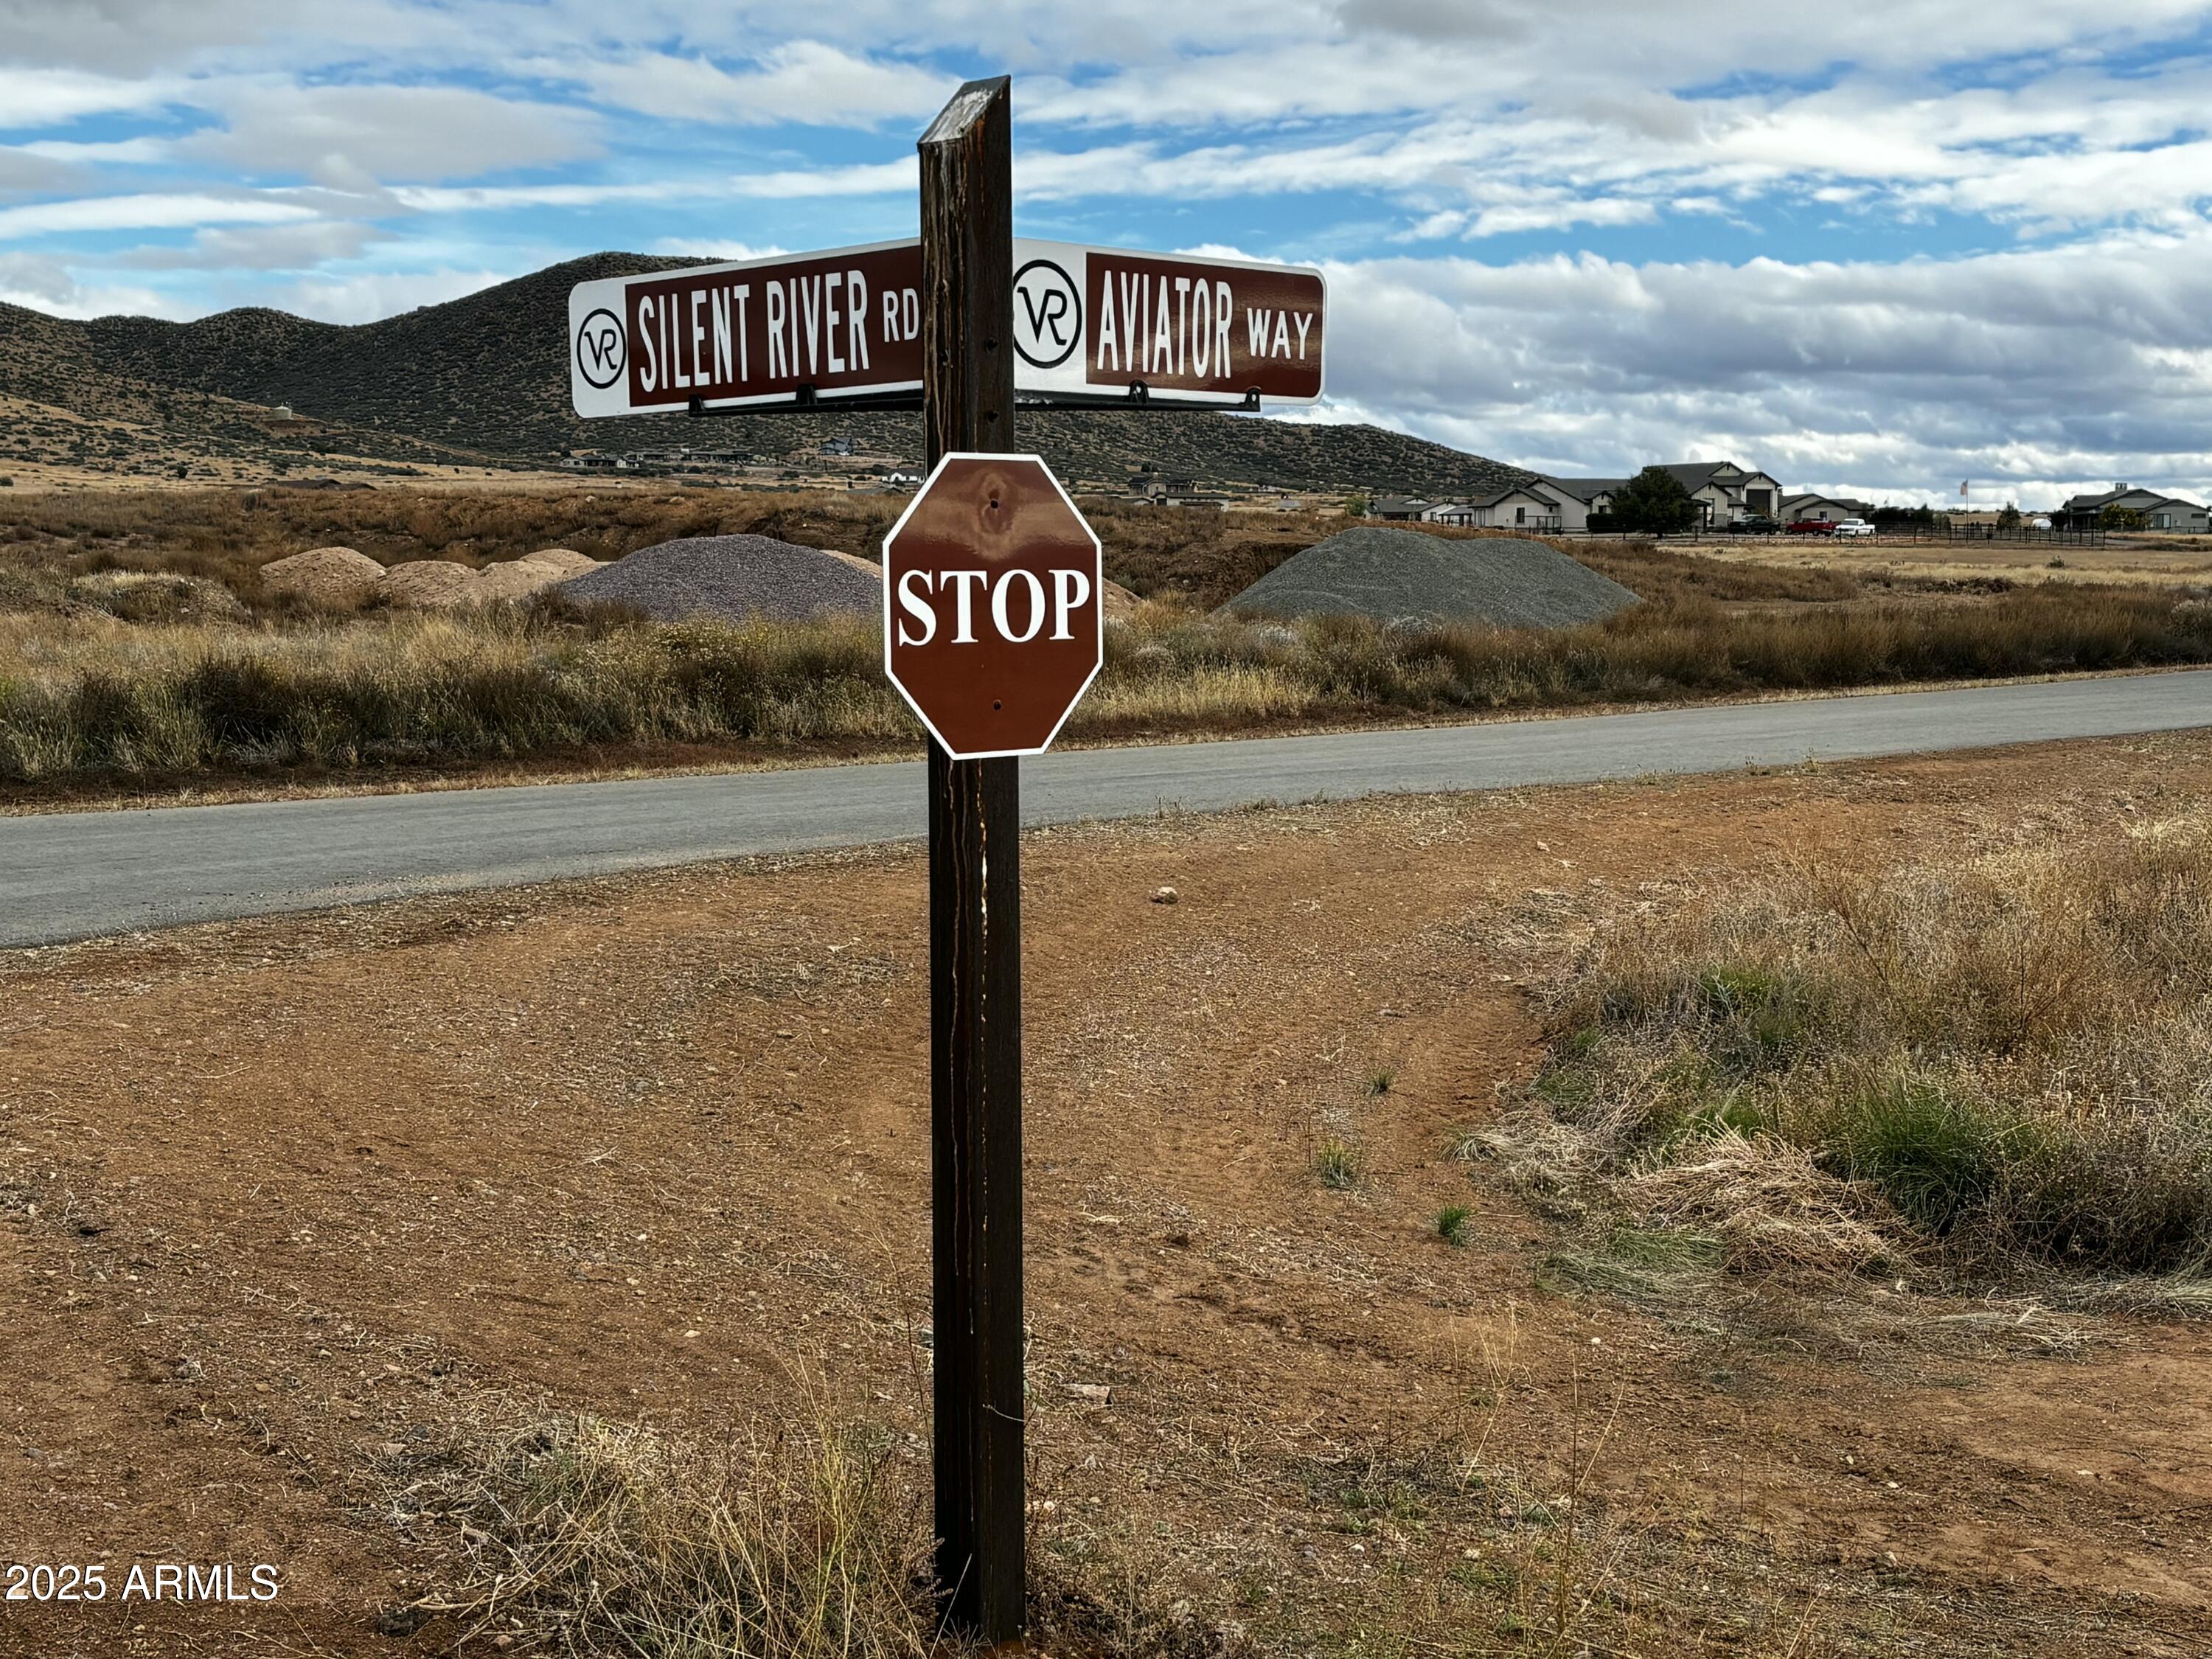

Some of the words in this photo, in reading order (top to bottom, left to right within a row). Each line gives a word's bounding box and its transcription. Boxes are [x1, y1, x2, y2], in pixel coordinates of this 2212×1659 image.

[584, 328, 617, 370] VR
[639, 284, 750, 392] SILENT
[766, 270, 869, 379] RIVER
[883, 288, 919, 342] RD
[1017, 286, 1068, 346] VR
[1097, 270, 1233, 378] AVIATOR
[1247, 307, 1313, 360] WAY
[897, 568, 1091, 647] STOP
